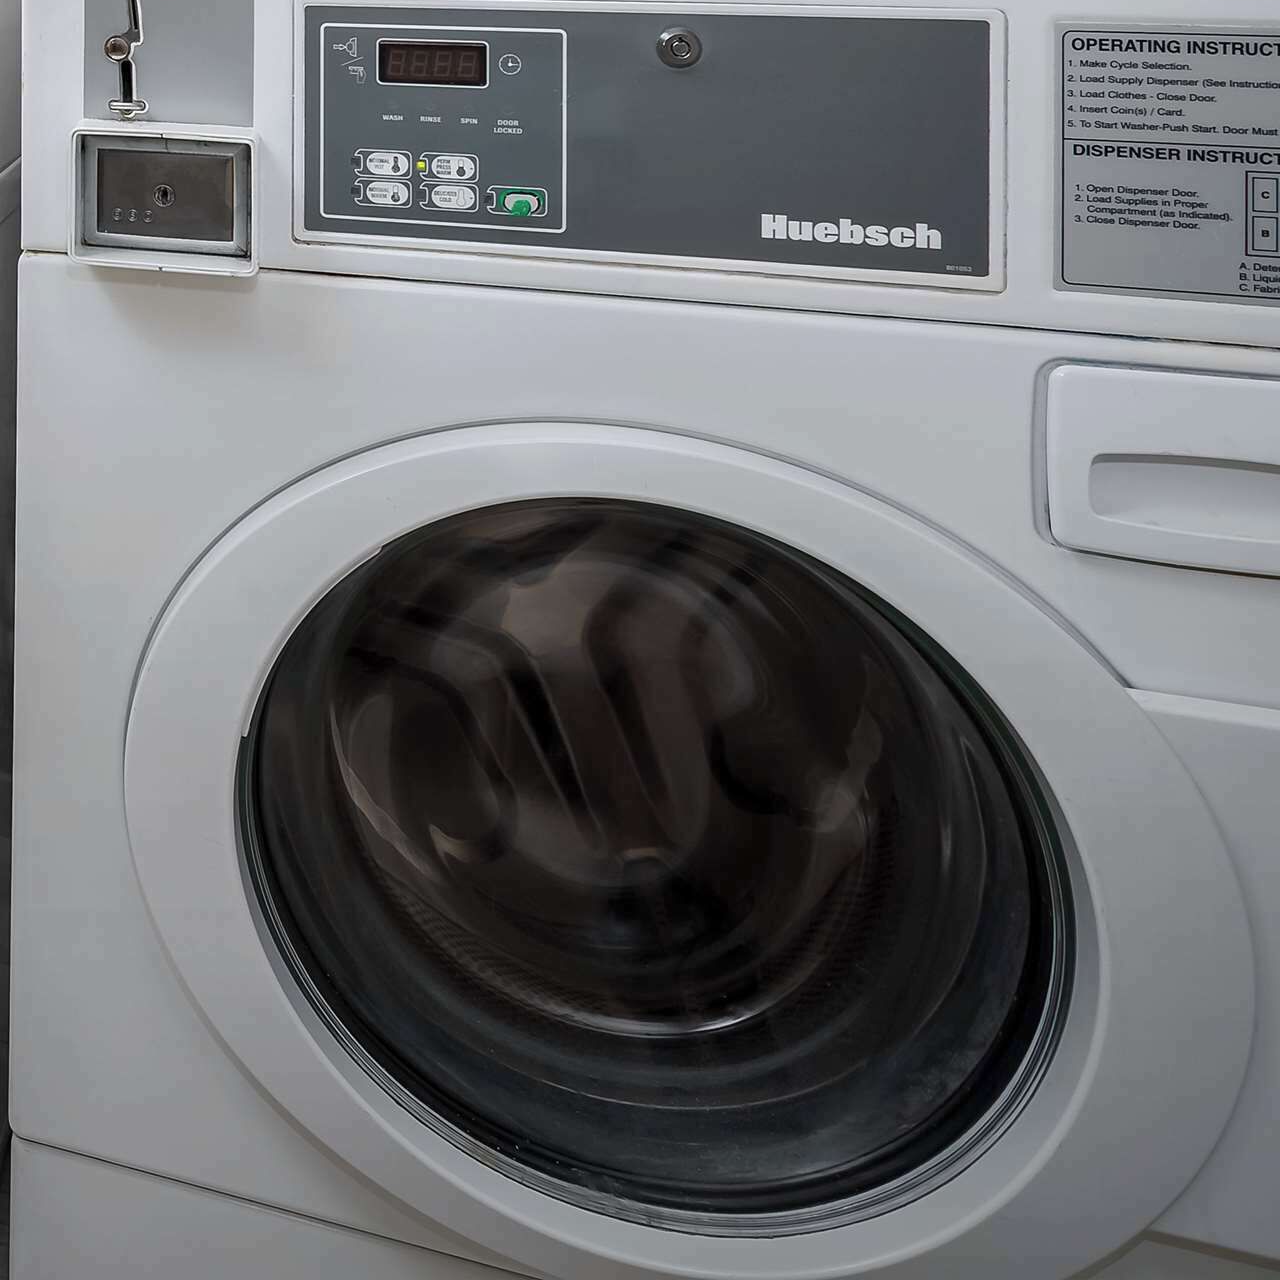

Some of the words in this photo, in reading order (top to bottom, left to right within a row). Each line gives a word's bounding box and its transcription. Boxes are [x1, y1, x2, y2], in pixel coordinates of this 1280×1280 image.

[1071, 37, 1181, 55] OPERATING
[1068, 59, 1077, 68] 1.
[1079, 59, 1107, 69] Make
[1109, 60, 1139, 71] Cycle
[1141, 61, 1192, 71] Selection.
[1067, 74, 1077, 83] 2.
[1079, 74, 1105, 84] Load
[1107, 75, 1143, 87] Supply
[1146, 76, 1199, 89] Dispenser
[1202, 78, 1226, 89] (See
[1229, 79, 1280, 90] Instructio
[1067, 89, 1077, 98] 3.
[1079, 89, 1105, 99] Load
[1107, 90, 1147, 100] Clothes
[1156, 92, 1186, 102] Close
[1189, 93, 1218, 103] Door.
[1067, 104, 1077, 113] 4.
[1079, 104, 1108, 114] Insert
[1110, 105, 1147, 117] Coin(s)
[1157, 107, 1185, 117] Card.
[419, 115, 441, 123] RINSE
[460, 117, 478, 125] SPIN
[493, 127, 523, 135] LOCKED
[1067, 120, 1077, 128] 5.
[1080, 120, 1092, 129] To
[1094, 121, 1118, 130] Start
[1121, 122, 1189, 133] Washer-Push
[1222, 125, 1249, 135] Door
[1251, 126, 1279, 137] Must
[1072, 143, 1181, 161] DISPENSER
[1075, 183, 1084, 192] 1.
[1086, 184, 1115, 195] Open
[1117, 185, 1169, 197] Dispenser
[1171, 188, 1200, 199] Door.
[1260, 191, 1270, 200] C
[1074, 194, 1084, 203] 2.
[1086, 194, 1112, 204] Load
[1114, 195, 1159, 207] Supplies
[1161, 197, 1171, 207] in
[1173, 199, 1209, 210] Proper
[1086, 205, 1157, 217] Compartment
[1159, 209, 1176, 219] (as
[1178, 210, 1233, 222] Indicated).
[1074, 215, 1084, 224] 3.
[1086, 215, 1115, 225] Close
[1118, 216, 1170, 229] Dispenser
[1172, 220, 1201, 230] Door.
[760, 213, 942, 250] Huebsch
[1261, 229, 1270, 238] B
[1239, 262, 1250, 271] A.
[1239, 272, 1250, 282] B.
[1239, 283, 1250, 292] C.
